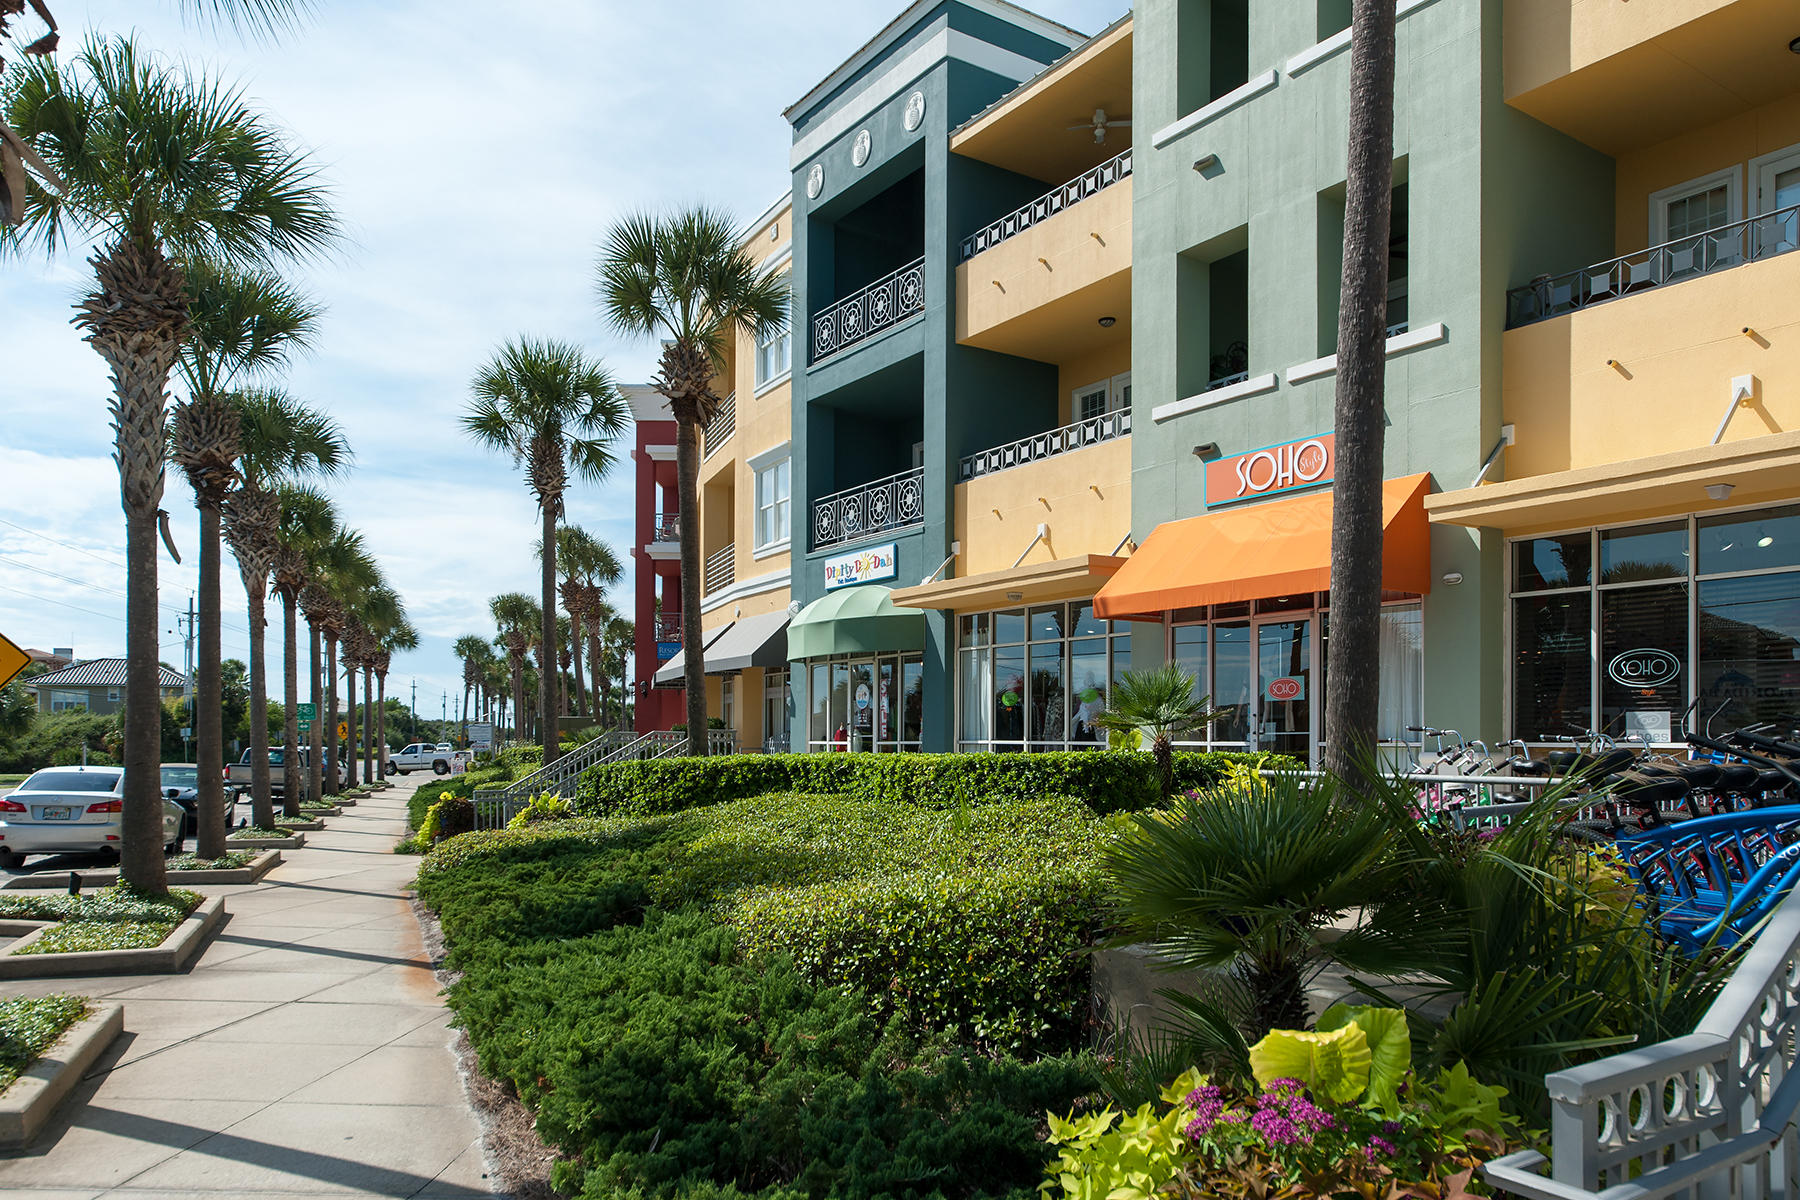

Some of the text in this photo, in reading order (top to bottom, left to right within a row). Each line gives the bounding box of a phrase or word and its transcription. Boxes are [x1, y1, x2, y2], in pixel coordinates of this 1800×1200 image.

[1236, 440, 1328, 496] SOHO
[1299, 450, 1322, 473] Style
[874, 553, 893, 568] Dah
[1620, 659, 1667, 676] SOHO
[1272, 683, 1297, 695] SOHO
[880, 679, 888, 740] SALE
